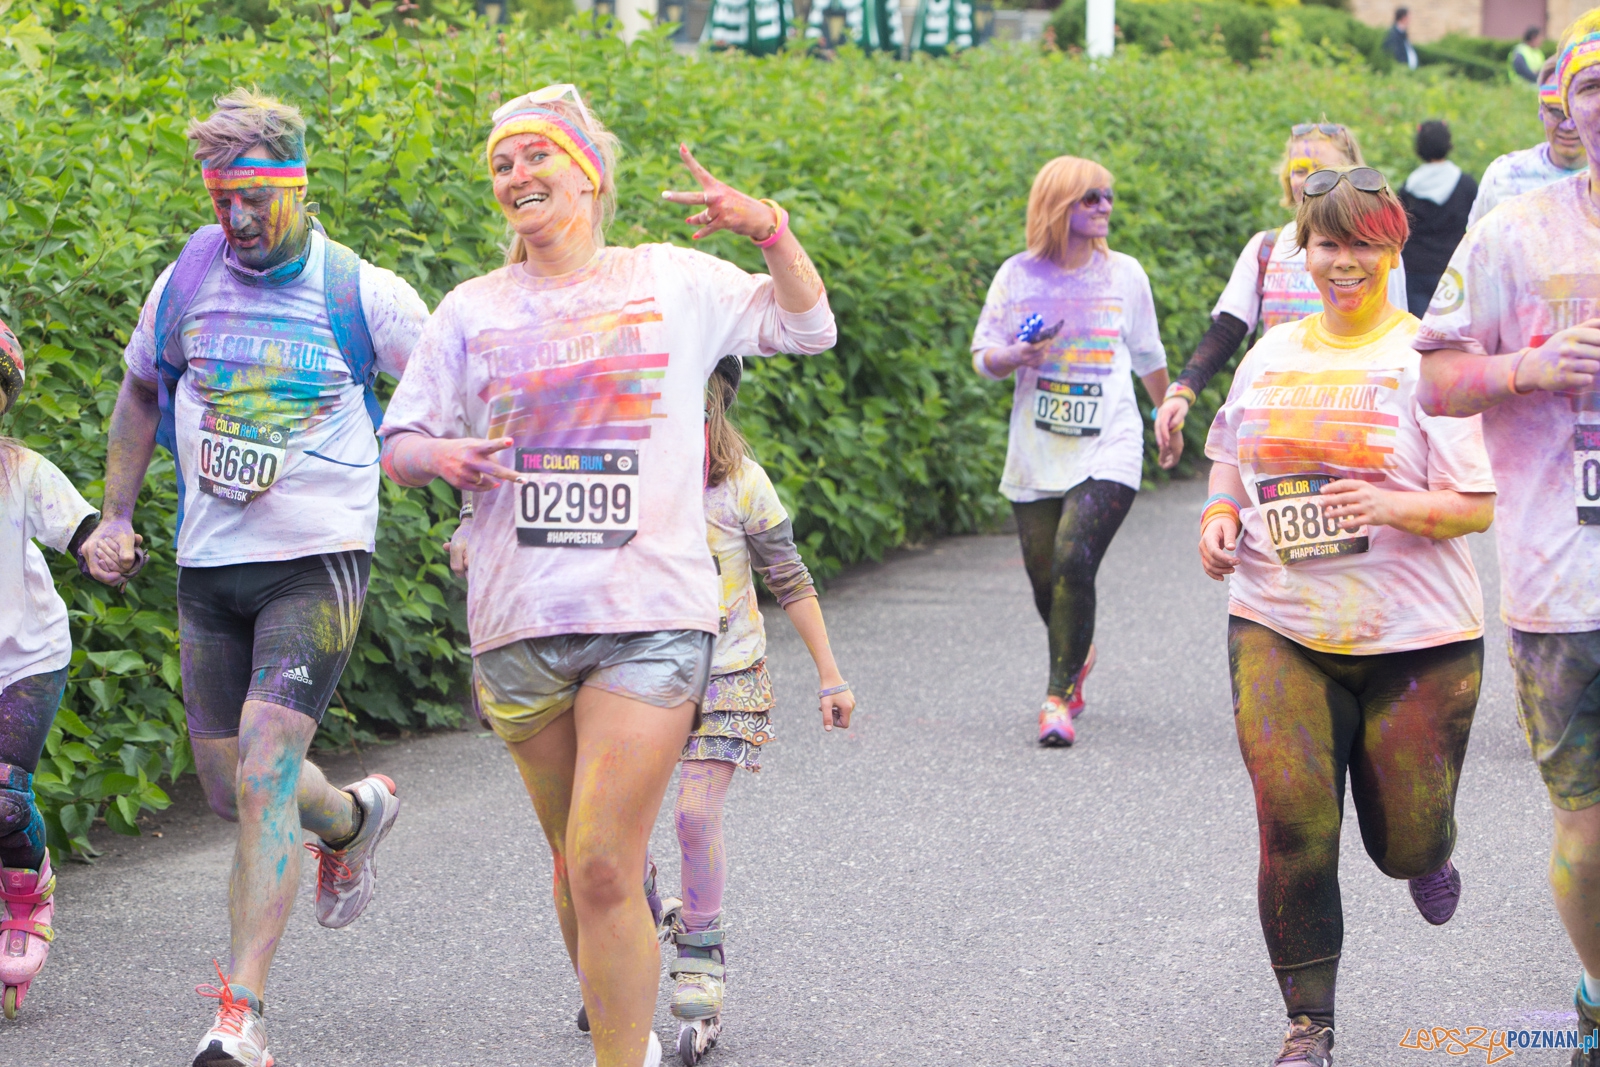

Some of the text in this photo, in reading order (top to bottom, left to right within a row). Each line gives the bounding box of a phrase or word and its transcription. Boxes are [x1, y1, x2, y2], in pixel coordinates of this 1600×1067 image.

[192, 334, 221, 360] THE
[221, 335, 287, 365] COLOR
[1250, 387, 1284, 407] THE
[1279, 386, 1340, 409] COLOR
[1037, 395, 1099, 424] 02307
[205, 415, 217, 430] THE
[215, 418, 240, 436] COLOR
[200, 438, 278, 488] 03680
[522, 453, 542, 469] THE
[543, 454, 580, 471] COLOR
[1262, 485, 1277, 499] THE
[1277, 480, 1310, 497] COLOR
[521, 481, 631, 524] 02999
[546, 531, 604, 545] #HAPPIEST5K
[1289, 542, 1340, 560] #HAPPIEST5K
[282, 671, 313, 686] adidas
